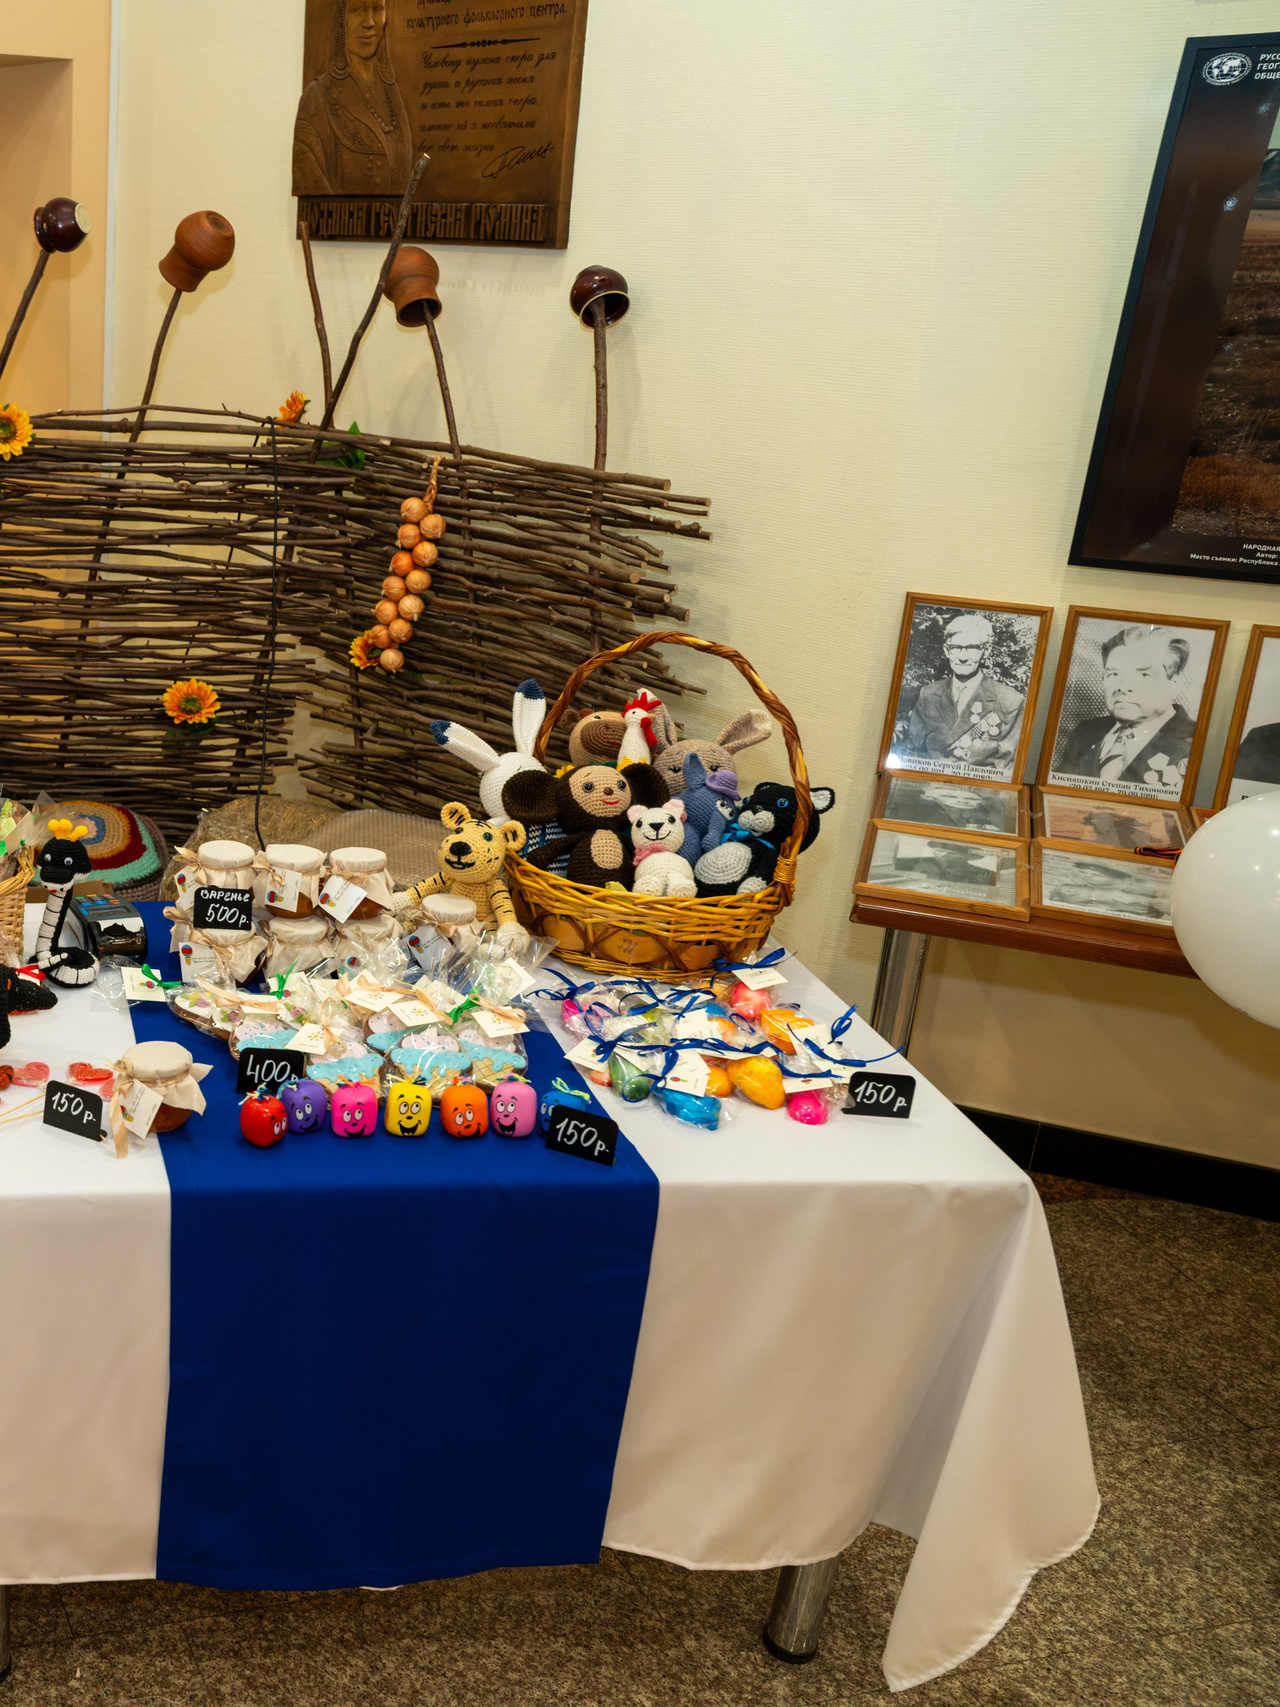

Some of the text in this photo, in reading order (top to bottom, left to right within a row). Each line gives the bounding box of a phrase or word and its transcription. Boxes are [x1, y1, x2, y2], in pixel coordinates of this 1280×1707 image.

[406, 2, 568, 34] культурного фольклорного центра.
[534, 51, 557, 69] для
[461, 75, 503, 94] русская
[371, 202, 467, 239] ГЕОГИЕВНА
[1190, 553, 1278, 567] Место съемки: Республика
[1255, 552, 1278, 560] Автор:
[933, 760, 962, 771] Сергей
[963, 764, 1005, 776] Павлович
[1101, 780, 1132, 791] Степан
[1133, 784, 1179, 796] Тихонович
